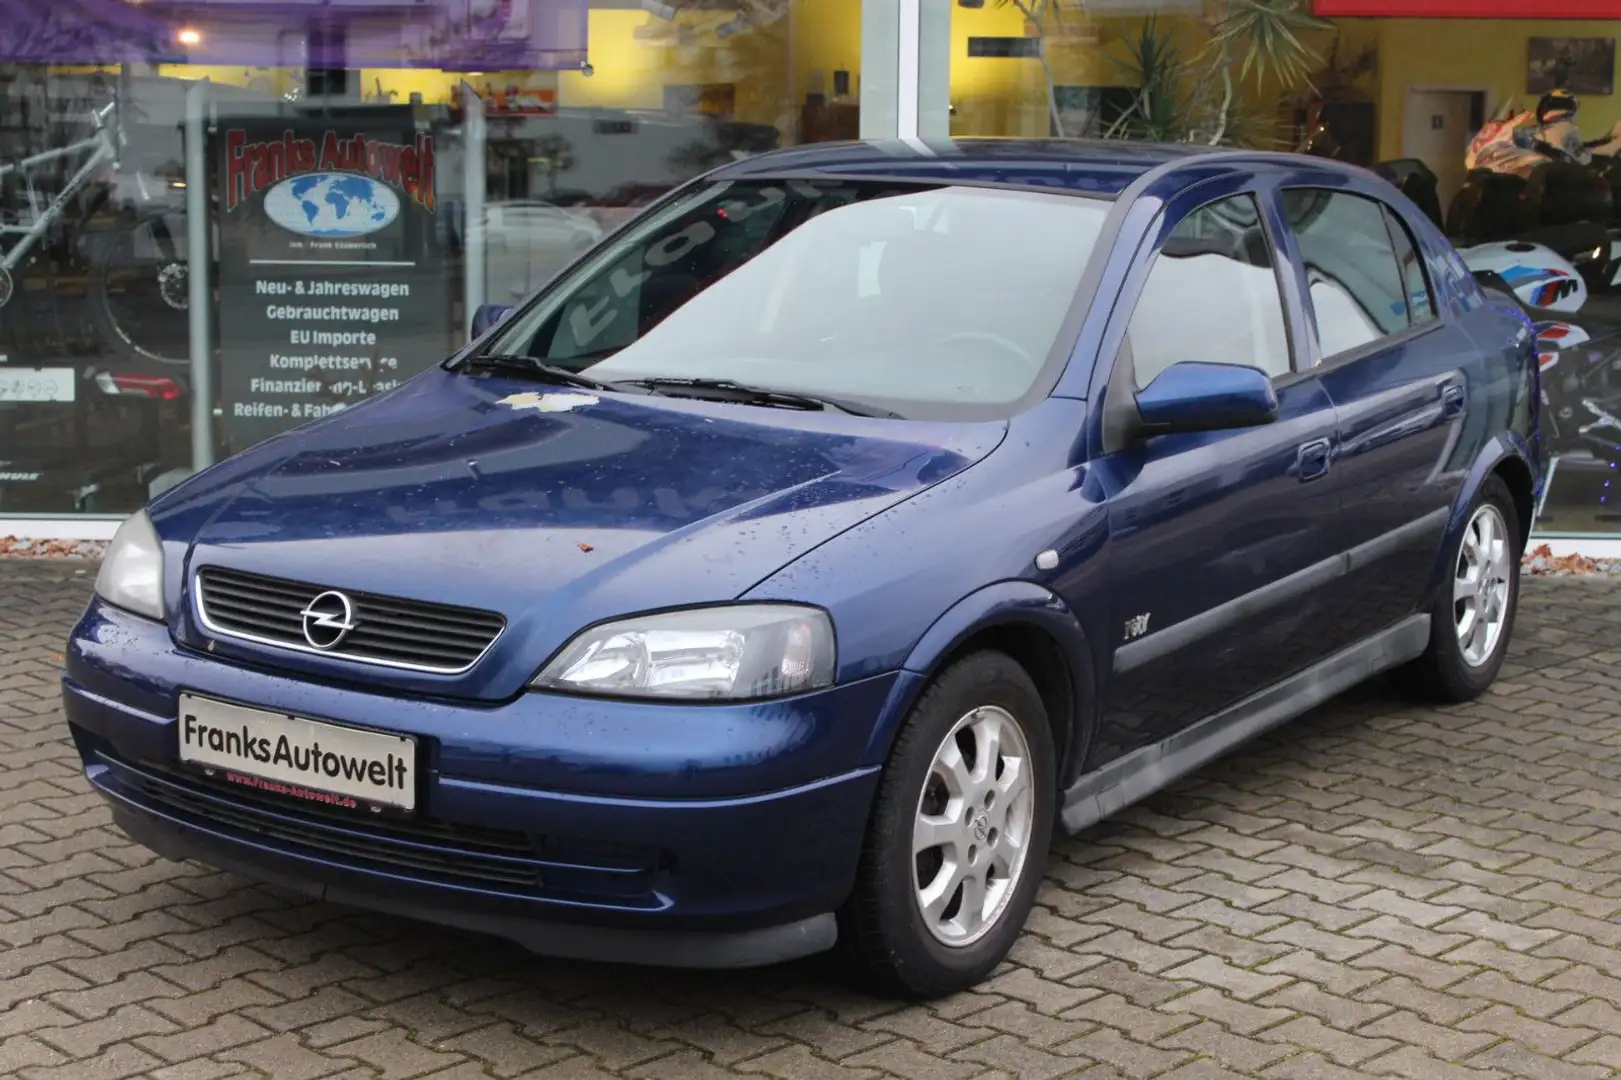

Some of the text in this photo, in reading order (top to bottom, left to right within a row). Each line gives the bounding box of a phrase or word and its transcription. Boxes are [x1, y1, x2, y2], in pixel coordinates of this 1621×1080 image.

[226, 129, 437, 214] Franks Autowelt
[256, 280, 409, 298] Neu- & Jahreswagen
[266, 305, 399, 322] Gebrauchtwagen
[290, 330, 377, 347] EU Importe
[234, 403, 289, 417] Reifen-
[291, 403, 301, 417] &
[184, 714, 408, 790] FranksAutowelt
